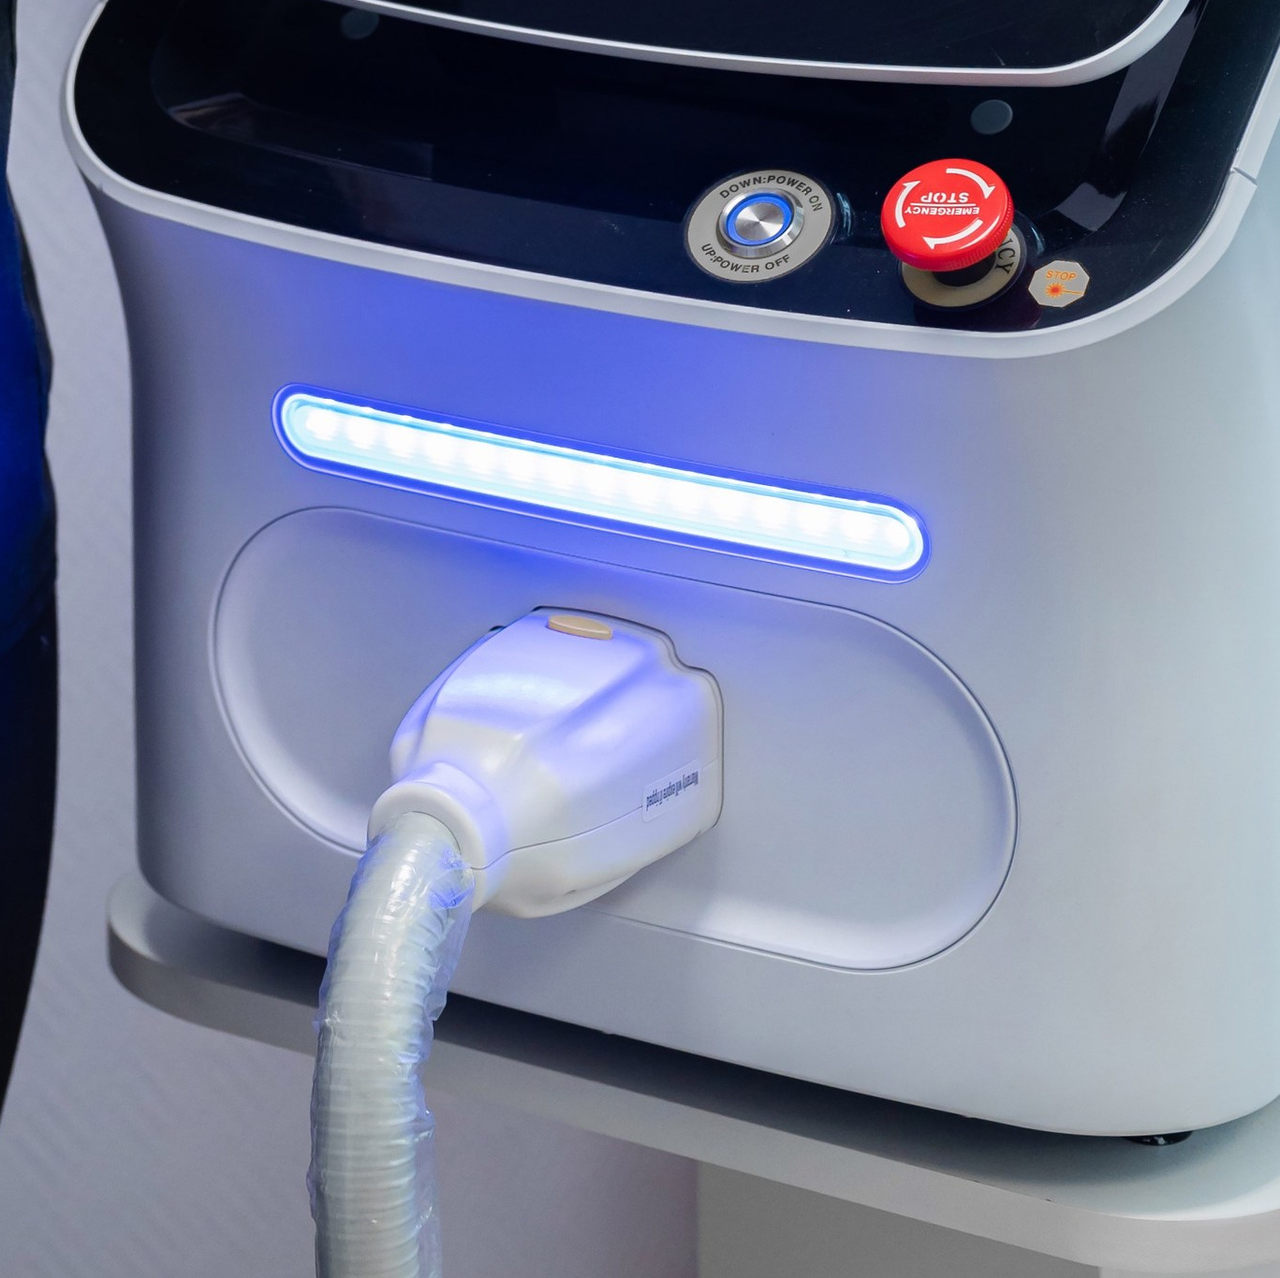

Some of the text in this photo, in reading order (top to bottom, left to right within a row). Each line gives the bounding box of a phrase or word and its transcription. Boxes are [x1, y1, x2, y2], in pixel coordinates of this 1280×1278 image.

[719, 175, 823, 212] DOWN:POWER ON
[920, 192, 970, 203] STOP
[904, 206, 980, 216] EMERGENCY
[701, 243, 791, 274] UP:POWER OFF
[1045, 270, 1077, 281] STOP
